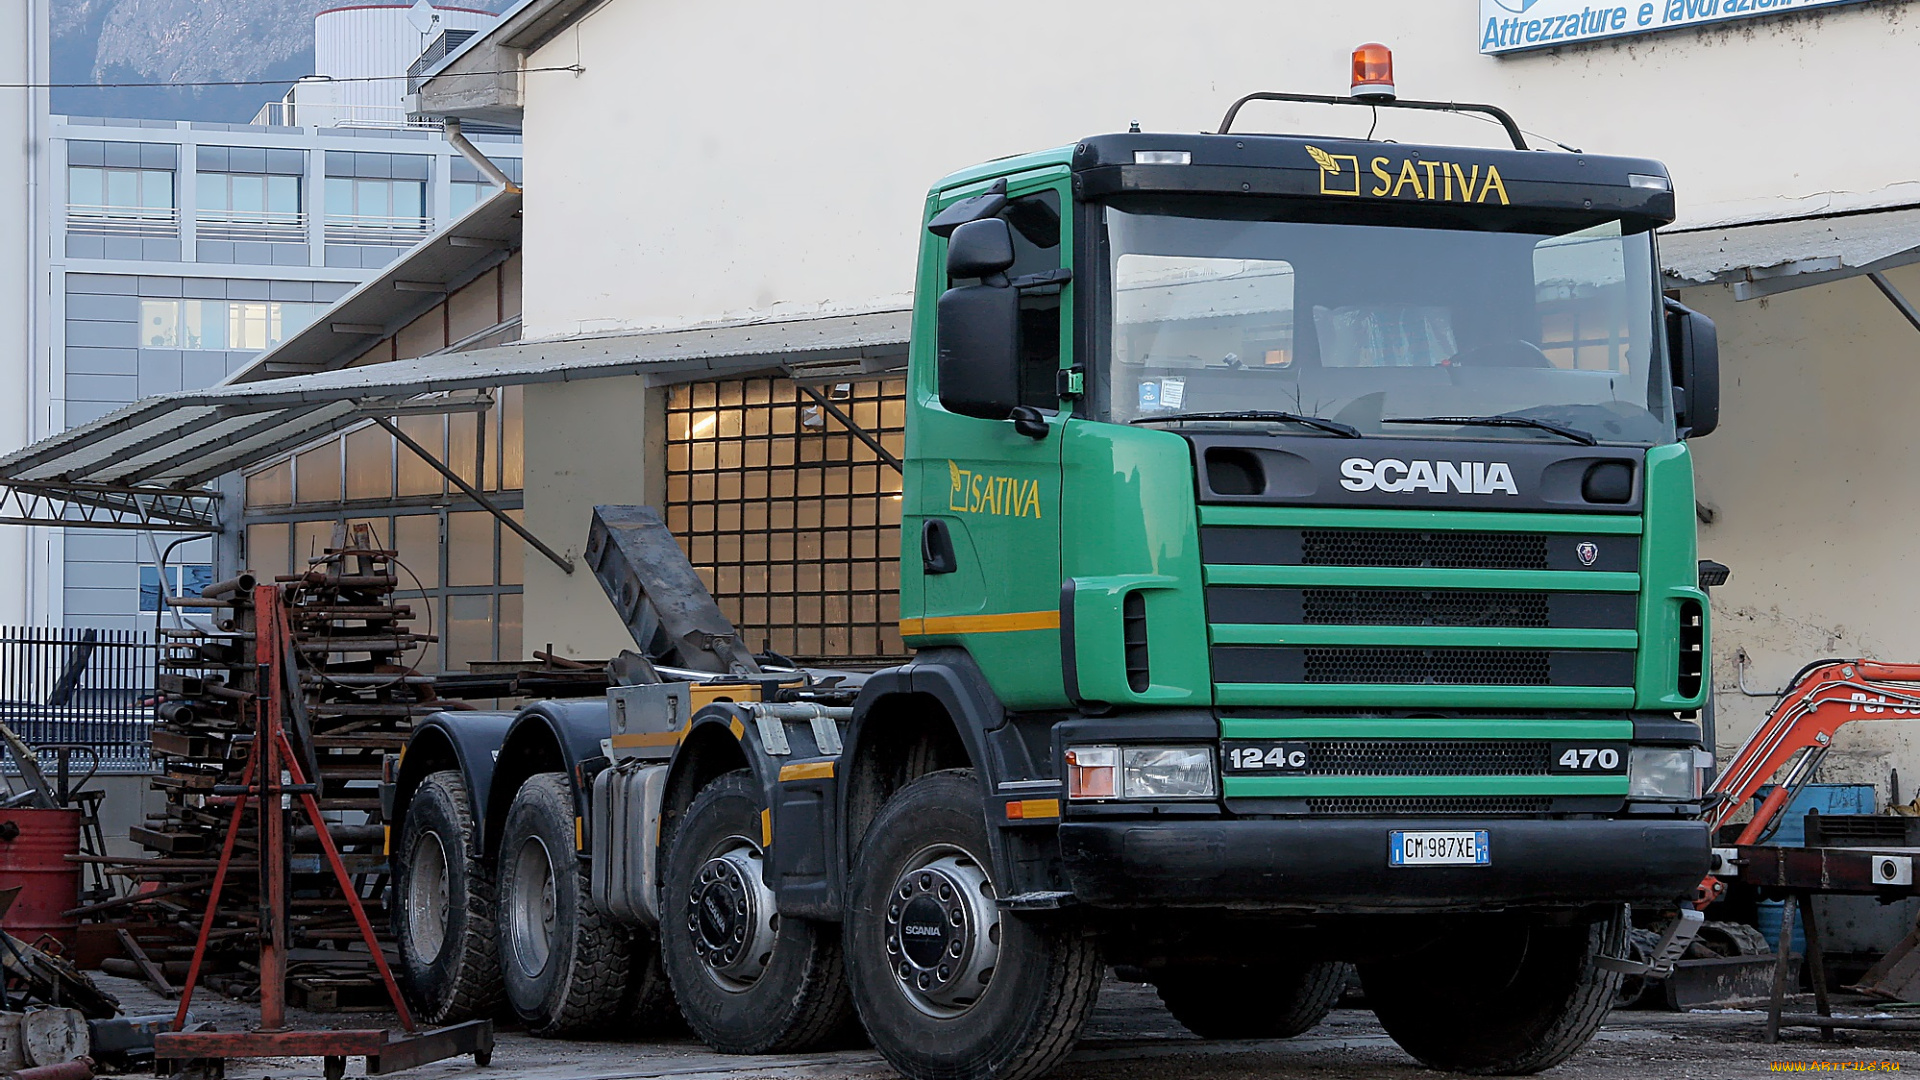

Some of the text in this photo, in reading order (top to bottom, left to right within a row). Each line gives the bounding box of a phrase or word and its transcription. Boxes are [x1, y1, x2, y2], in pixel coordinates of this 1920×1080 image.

[1481, 0, 1792, 50] Attrezzature e lavoraz
[1370, 156, 1511, 206] SATIVA
[970, 474, 1042, 519] SATIVA
[1339, 457, 1519, 495] SCANIA
[1559, 748, 1619, 769] 470
[905, 925, 941, 936] SCANIA
